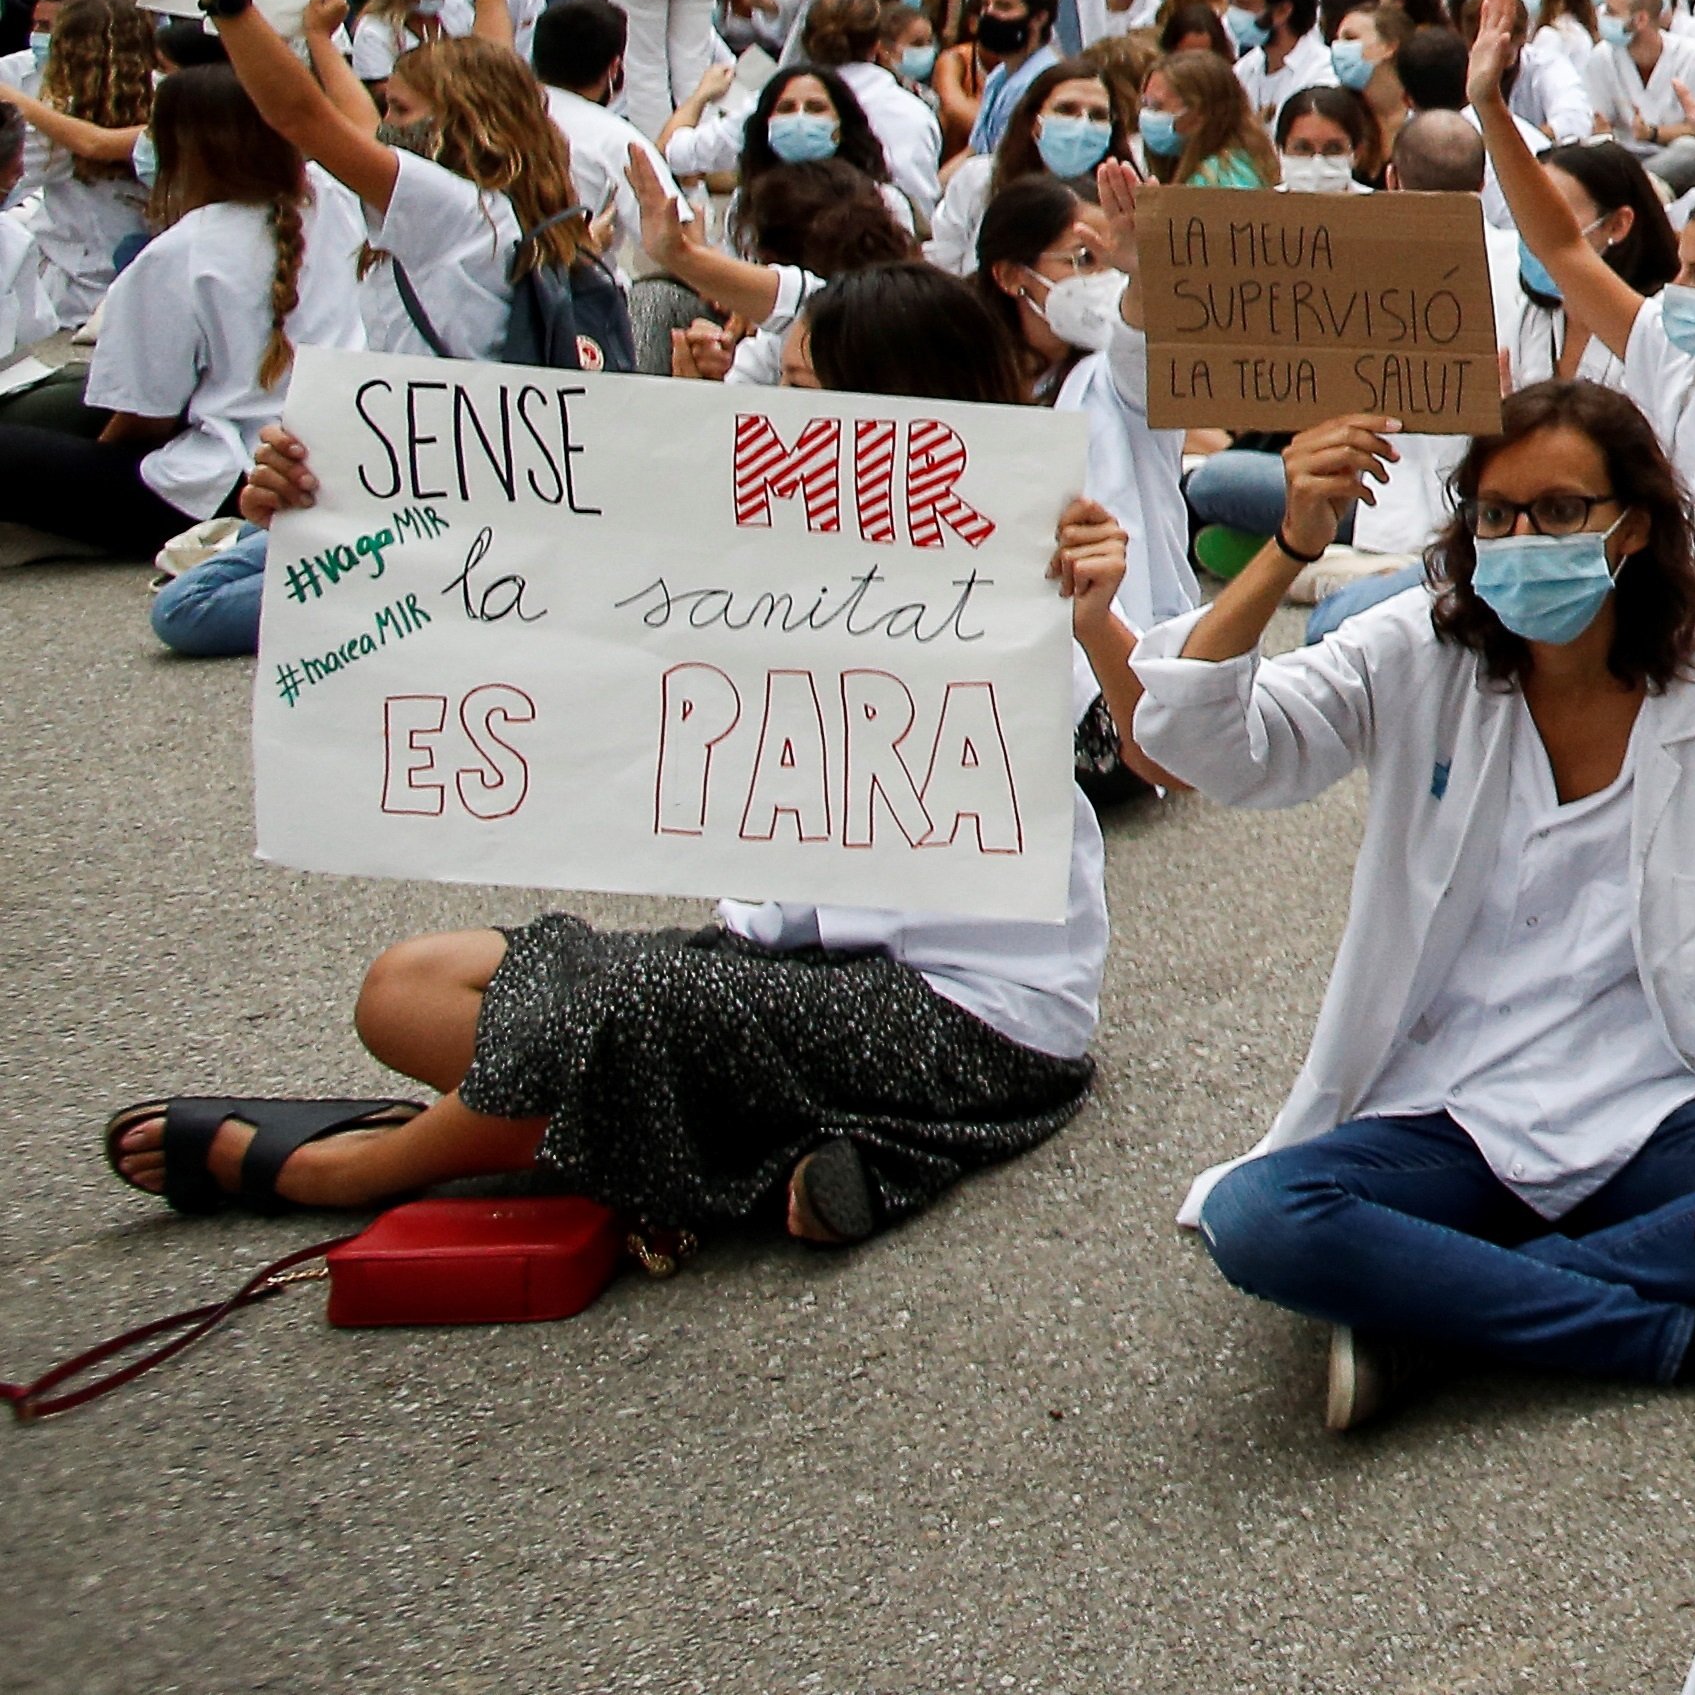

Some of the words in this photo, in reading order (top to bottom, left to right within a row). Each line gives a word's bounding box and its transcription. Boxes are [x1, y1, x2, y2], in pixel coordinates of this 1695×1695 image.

[1169, 217, 1208, 268] LA
[1230, 221, 1333, 270] MEUA
[1174, 265, 1462, 345] SUPERVISIÓ
[1170, 358, 1213, 400] LA
[1233, 358, 1317, 404] TEUA
[1354, 354, 1473, 416] SALUT
[355, 379, 602, 516] SENSE
[734, 412, 996, 549] MIR
[441, 526, 548, 623] la
[615, 564, 995, 643] sanitat
[275, 592, 432, 707] #mareaMIR
[380, 682, 536, 822] ES
[653, 661, 1023, 855] PARA
